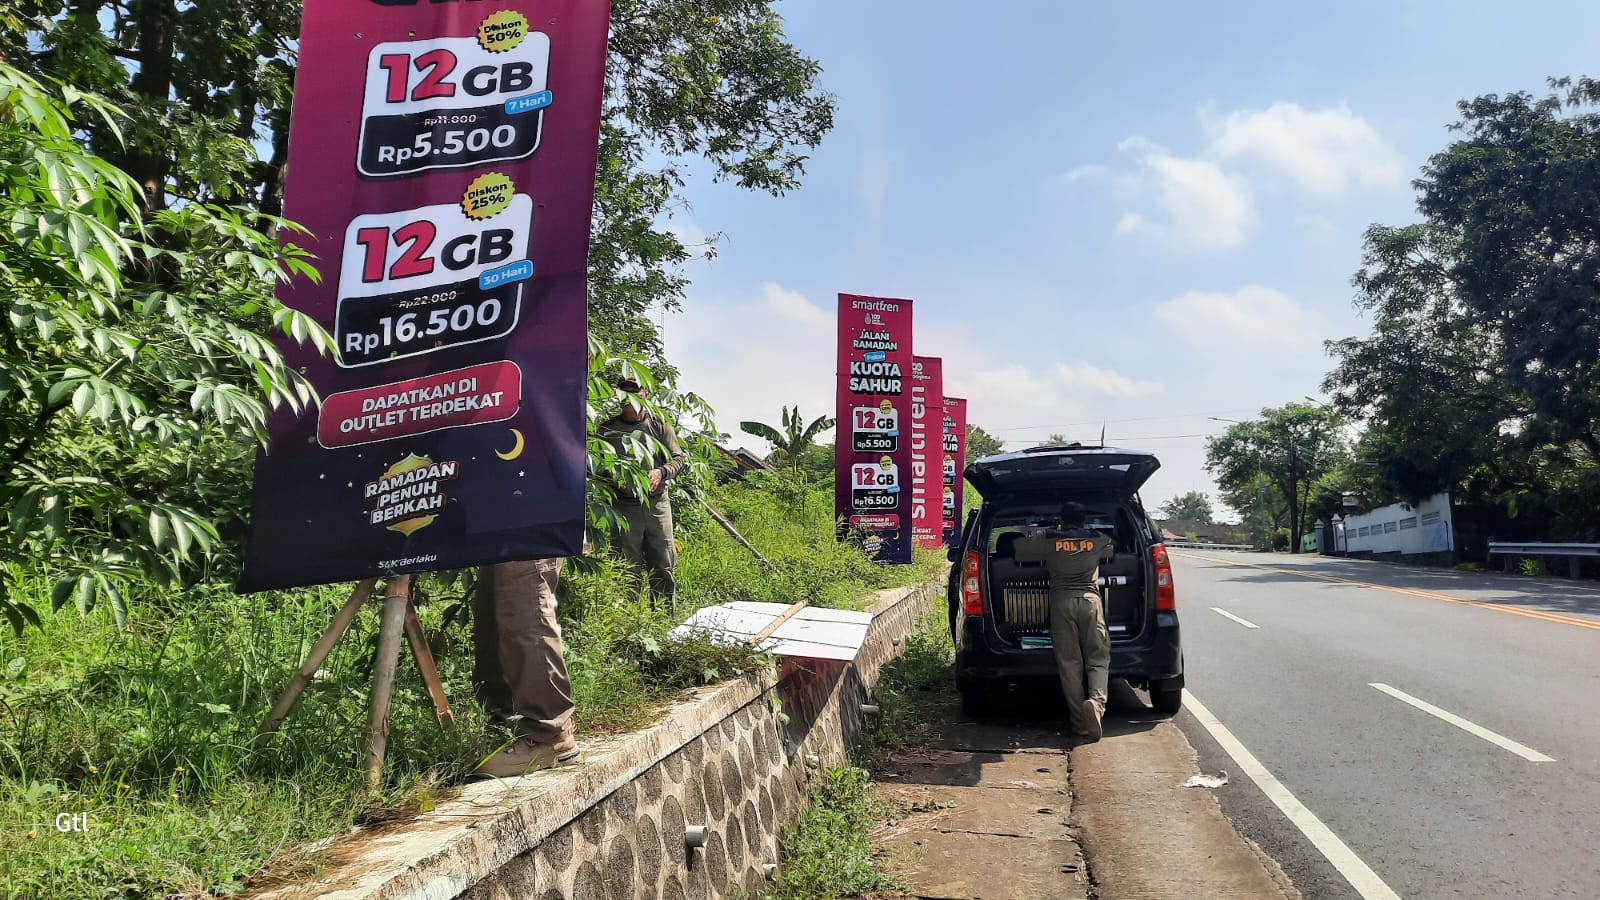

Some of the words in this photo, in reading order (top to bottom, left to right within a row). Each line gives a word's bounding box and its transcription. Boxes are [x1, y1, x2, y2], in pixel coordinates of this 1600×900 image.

[487, 29, 521, 43] 50%
[380, 49, 457, 103] 12
[462, 61, 533, 97] GB
[509, 100, 516, 111] 7
[520, 95, 547, 109] Hari
[378, 124, 516, 165] Rp5.500
[468, 183, 508, 199] Diskon
[471, 193, 505, 211] 25%
[356, 220, 437, 284] 12
[440, 228, 514, 271] GB
[483, 275, 500, 286] 30
[501, 264, 528, 280] Hari
[852, 301, 899, 312] smartfren
[345, 298, 501, 355] Rp16.500
[860, 331, 889, 340] JALANI
[853, 340, 897, 350] RAMADAN
[850, 361, 901, 376] KUOTA
[850, 378, 901, 392] SAHUR
[361, 383, 456, 413] DAPATKAN
[458, 377, 478, 394] DI
[339, 408, 408, 434] OUTLET
[409, 391, 504, 422] TERDEKAT
[855, 411, 875, 428] 12
[877, 418, 894, 429] GB
[857, 439, 892, 449] Rp5.500
[364, 461, 457, 499] RAMADAN
[855, 468, 875, 485] 12
[877, 474, 894, 485] GB
[379, 480, 438, 508] PENUH
[371, 494, 444, 524] BERKAH
